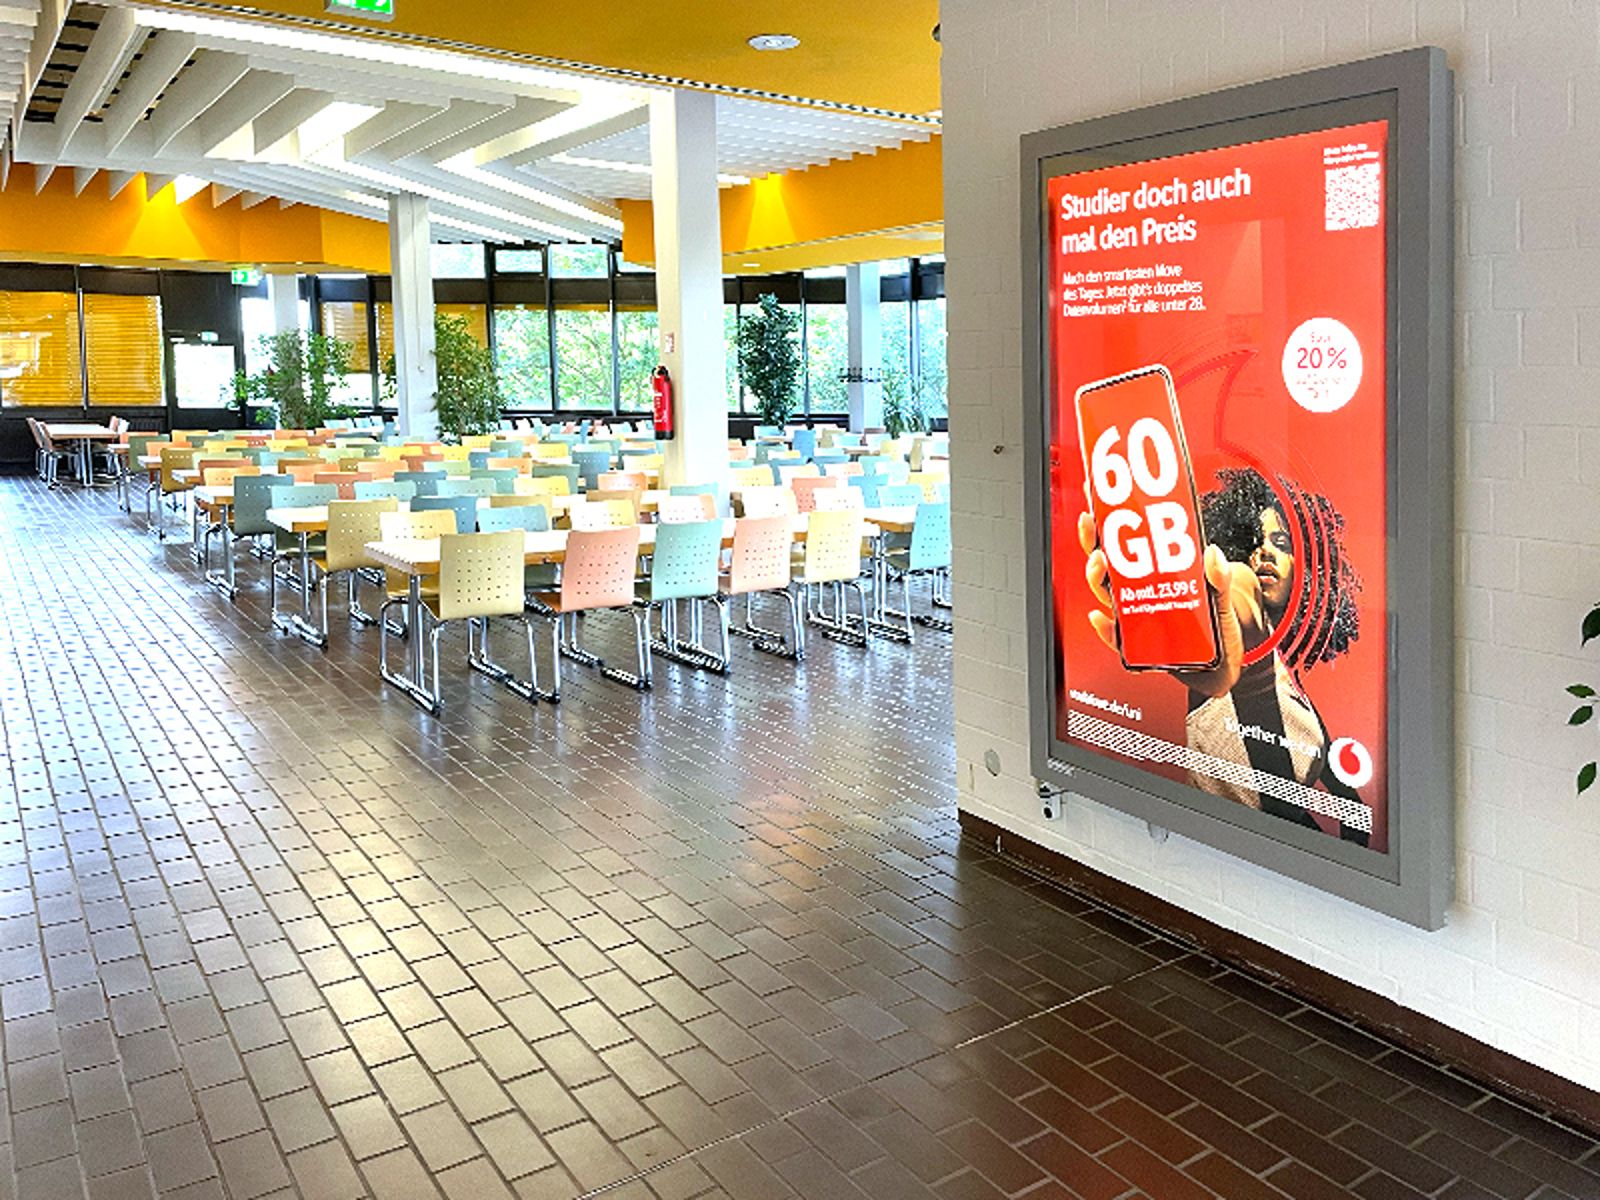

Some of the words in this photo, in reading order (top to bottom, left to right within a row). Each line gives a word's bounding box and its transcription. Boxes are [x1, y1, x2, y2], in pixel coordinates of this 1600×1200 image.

[1061, 187, 1131, 221] Studier
[1133, 177, 1188, 210] doch
[1191, 167, 1251, 203] auch
[1061, 225, 1097, 255] mal
[1099, 223, 1138, 250] den
[1141, 213, 1197, 245] Preis
[1155, 263, 1182, 277] Move
[1091, 417, 1178, 507] 60
[1103, 501, 1196, 579] GB
[1189, 579, 1199, 595] €
